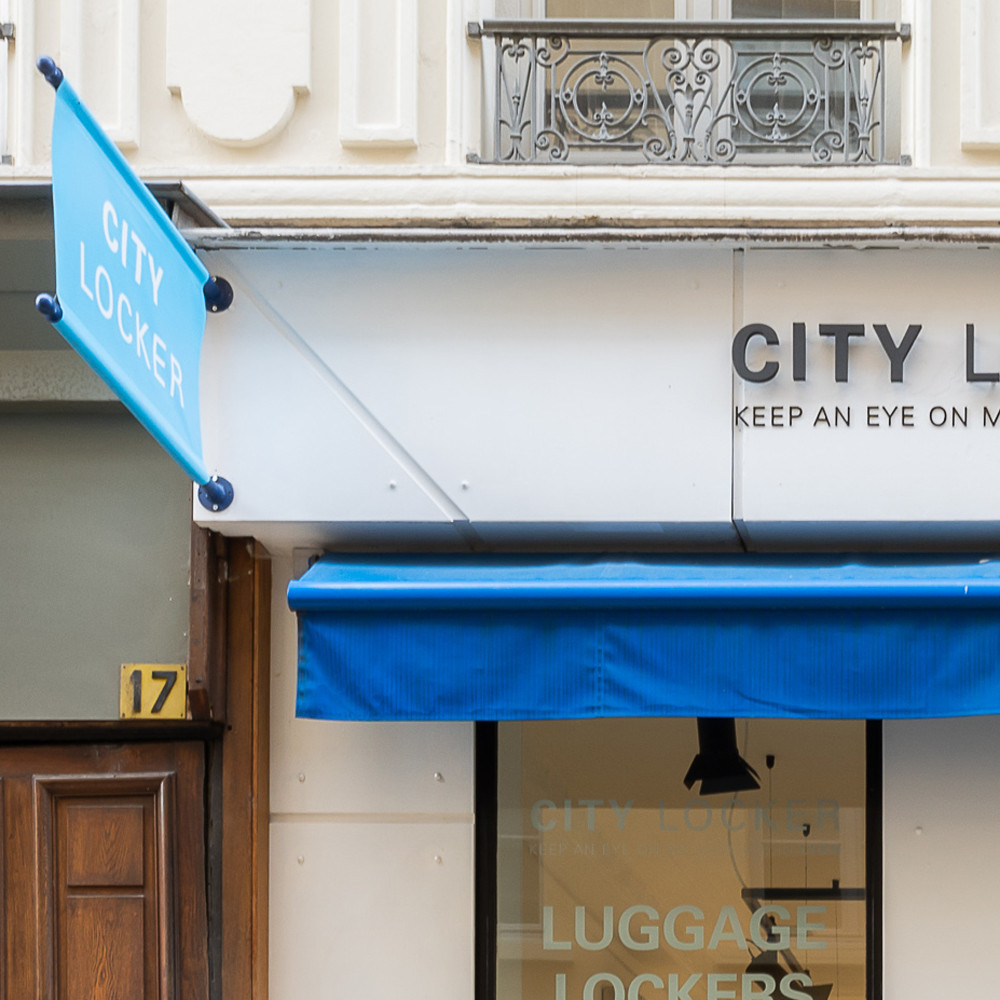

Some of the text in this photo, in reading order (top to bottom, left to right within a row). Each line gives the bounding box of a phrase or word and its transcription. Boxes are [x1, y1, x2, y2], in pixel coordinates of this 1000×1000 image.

[102, 199, 164, 307] CITY
[79, 240, 185, 409] LOCKER
[731, 322, 924, 384] CITY
[734, 406, 804, 429] KEEP
[812, 406, 852, 429] AN
[866, 406, 915, 429] EYE
[929, 406, 968, 429] ON
[130, 669, 178, 714] 17
[530, 799, 840, 832] CITY LOCKER
[542, 904, 828, 951] LUGGAGE
